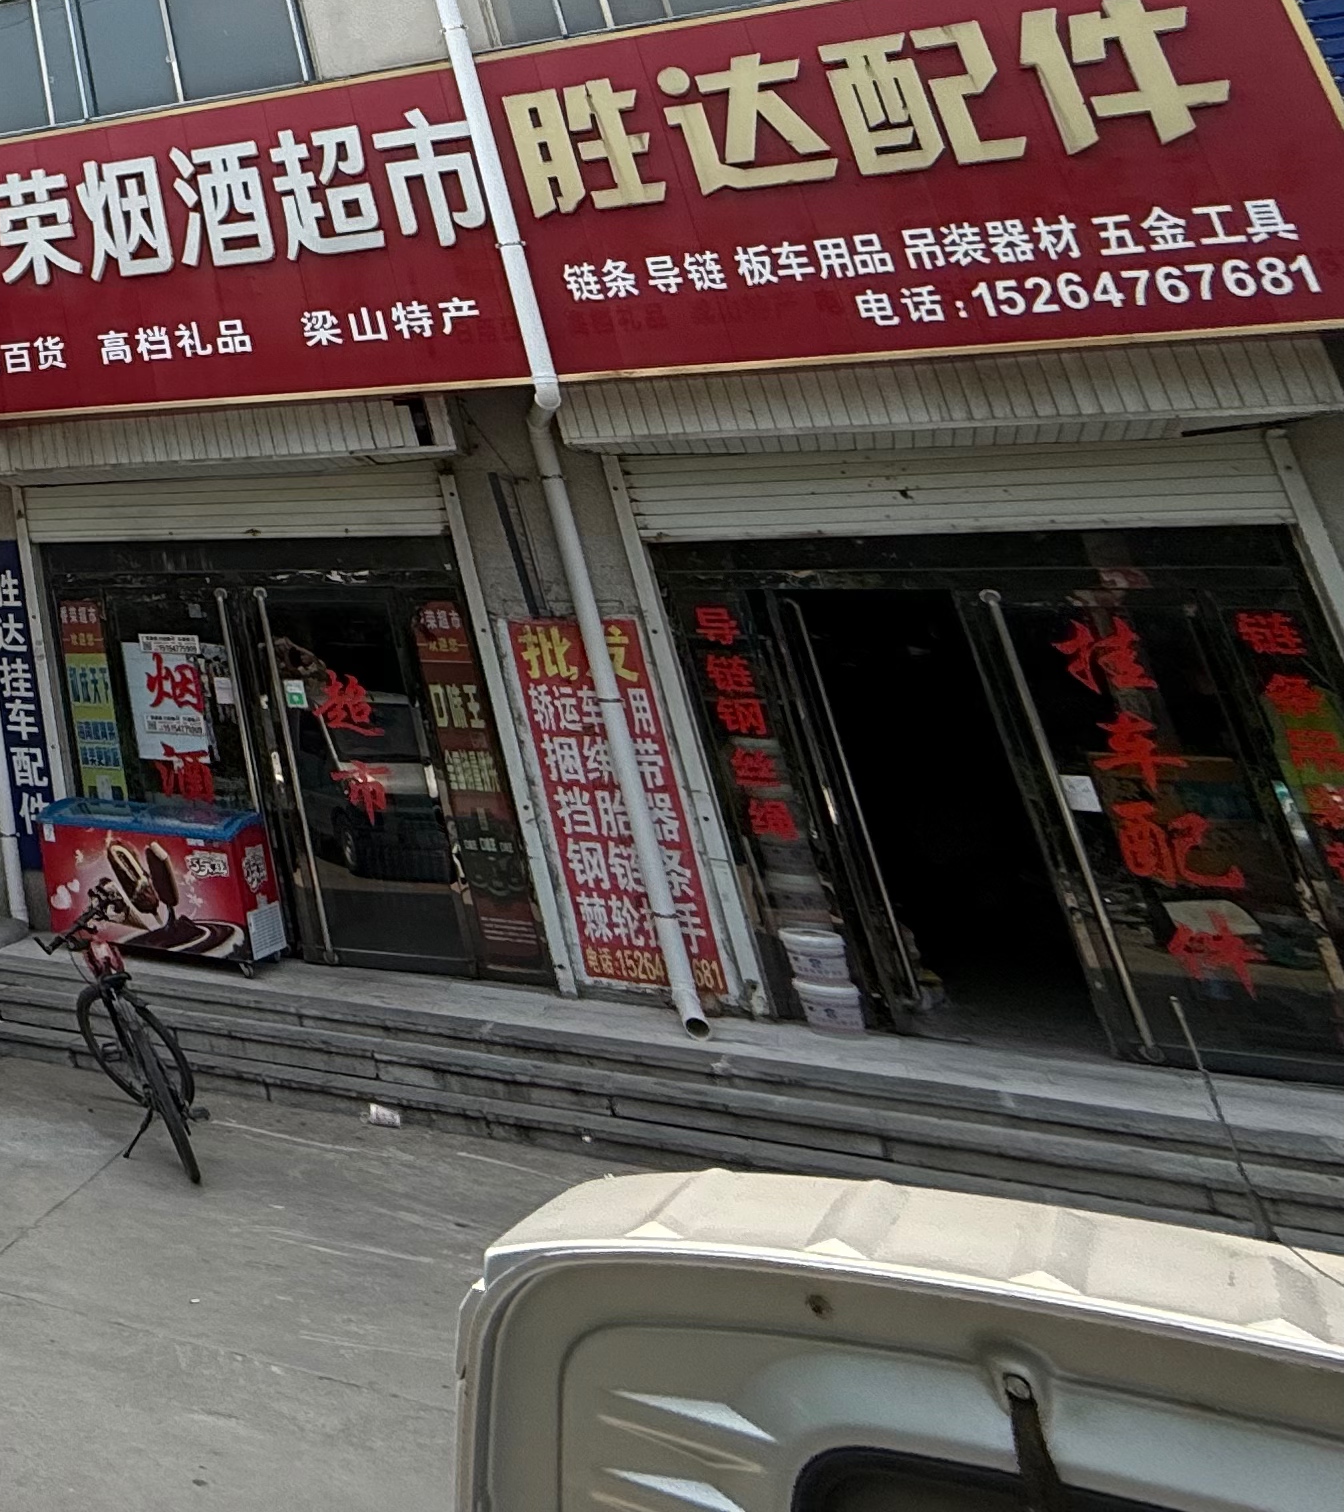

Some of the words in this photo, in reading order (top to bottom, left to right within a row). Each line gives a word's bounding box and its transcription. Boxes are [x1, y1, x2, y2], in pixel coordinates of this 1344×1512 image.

[564, 256, 640, 303] 链条
[647, 248, 728, 296] 导链
[734, 233, 895, 287] 板车用品
[902, 215, 1078, 273] 吊装器材
[1092, 198, 1300, 259] 五金工具
[856, 254, 1323, 327] 电话:15264767681
[97, 318, 253, 366] 高档礼品
[302, 296, 481, 347] 梁山特产
[420, 609, 463, 630] 荣超市
[427, 682, 487, 730] 口味王
[528, 683, 657, 736] 轿运车用
[694, 604, 801, 844] 导链钢丝绳
[314, 668, 390, 826] 超市
[1050, 615, 1268, 1000] 挂车配件
